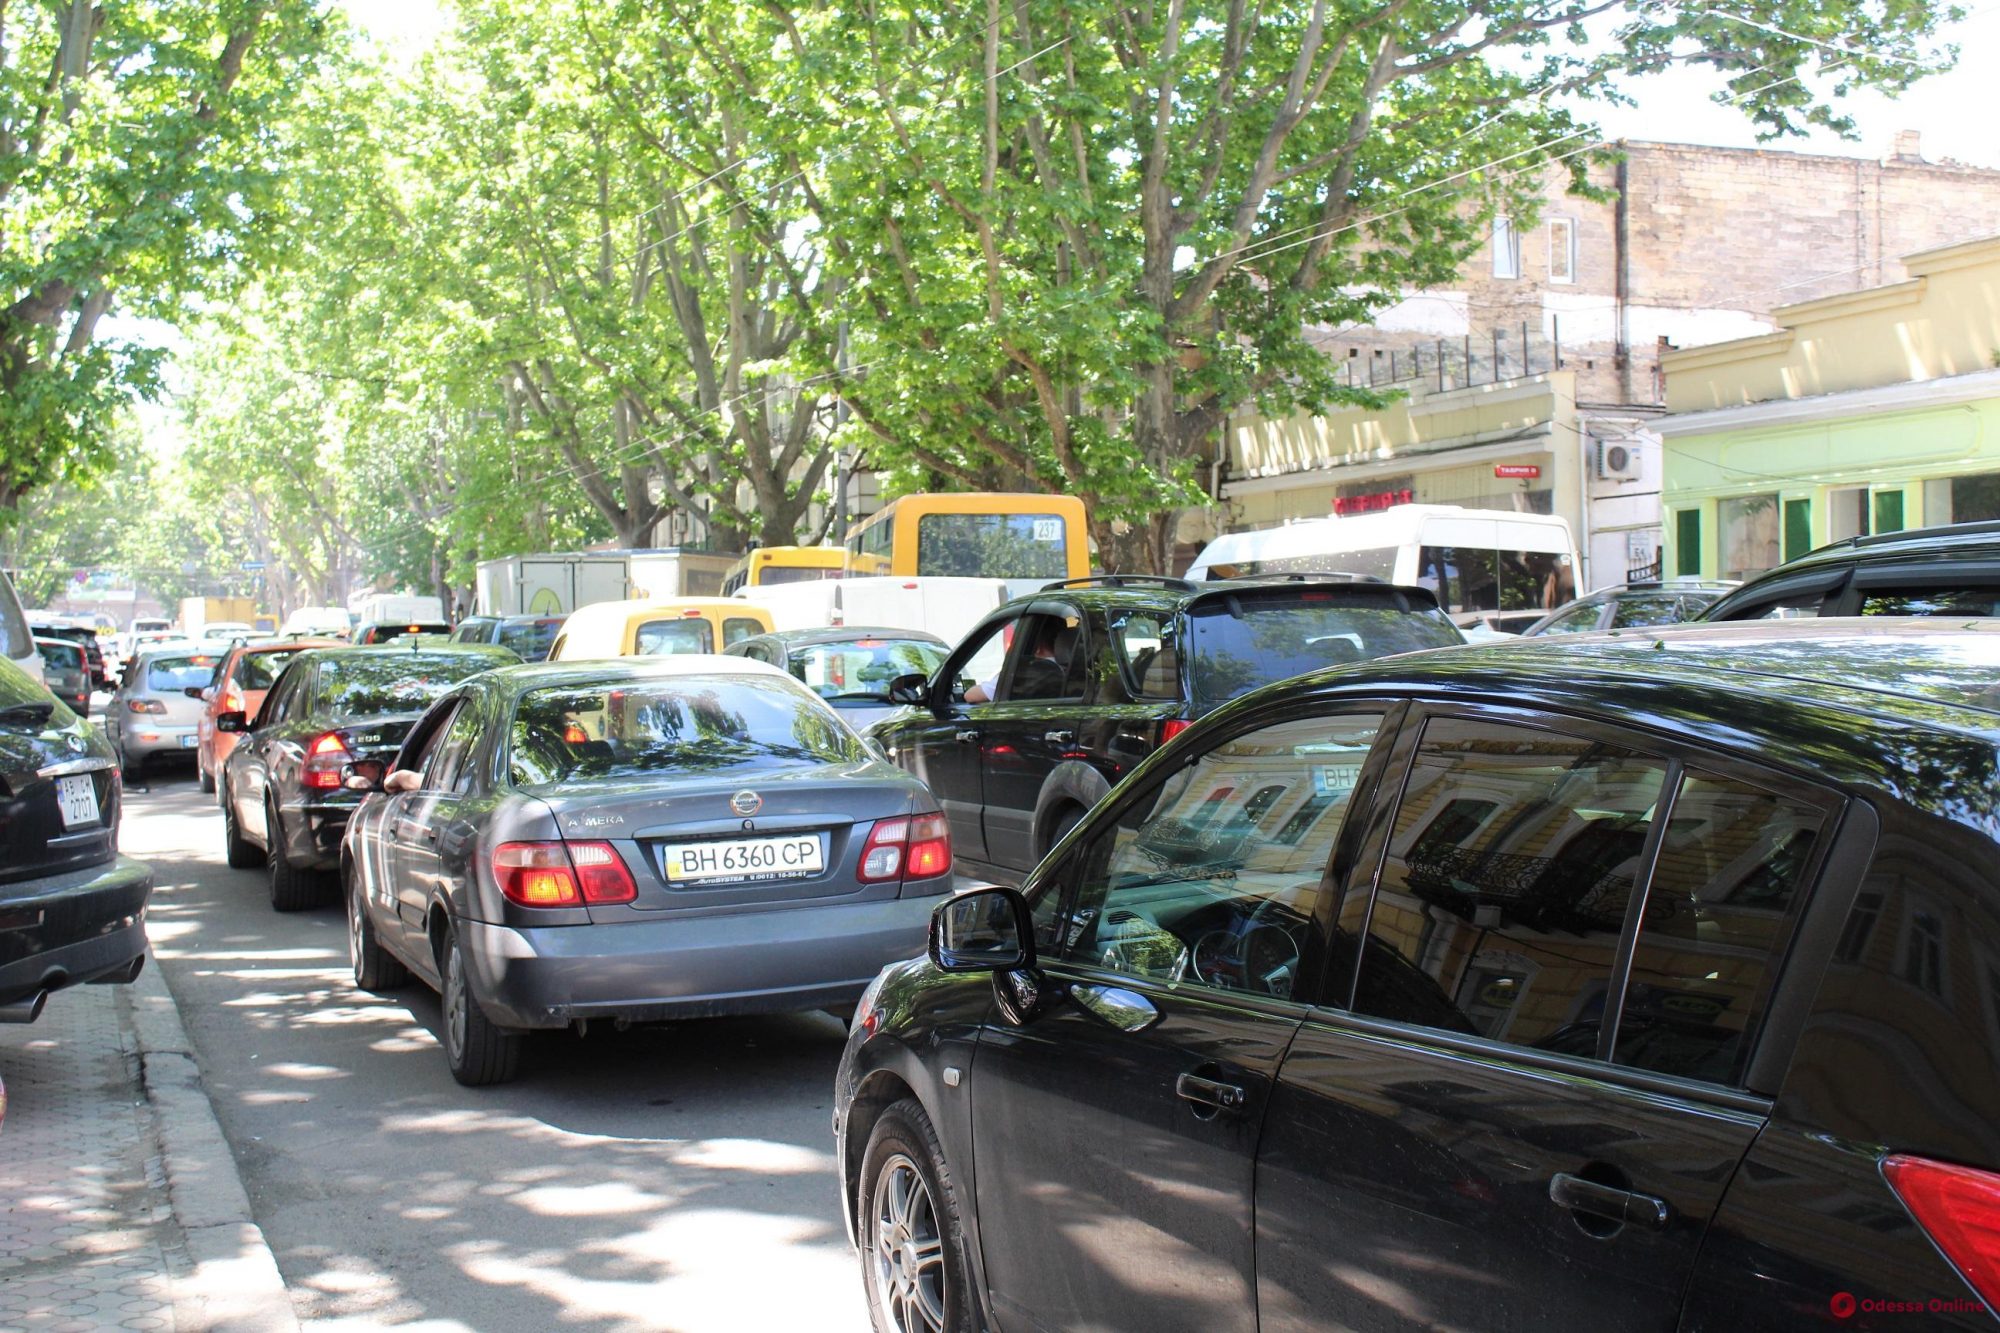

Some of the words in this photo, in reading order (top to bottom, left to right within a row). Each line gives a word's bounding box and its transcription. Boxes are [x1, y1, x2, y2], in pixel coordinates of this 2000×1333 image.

[1038, 521, 1055, 538] 237
[1324, 768, 1351, 787] BH
[71, 796, 92, 819] 2707
[568, 815, 624, 827] AMERA
[682, 848, 717, 872] BH
[723, 845, 776, 869] 6360
[782, 841, 814, 864] CP
